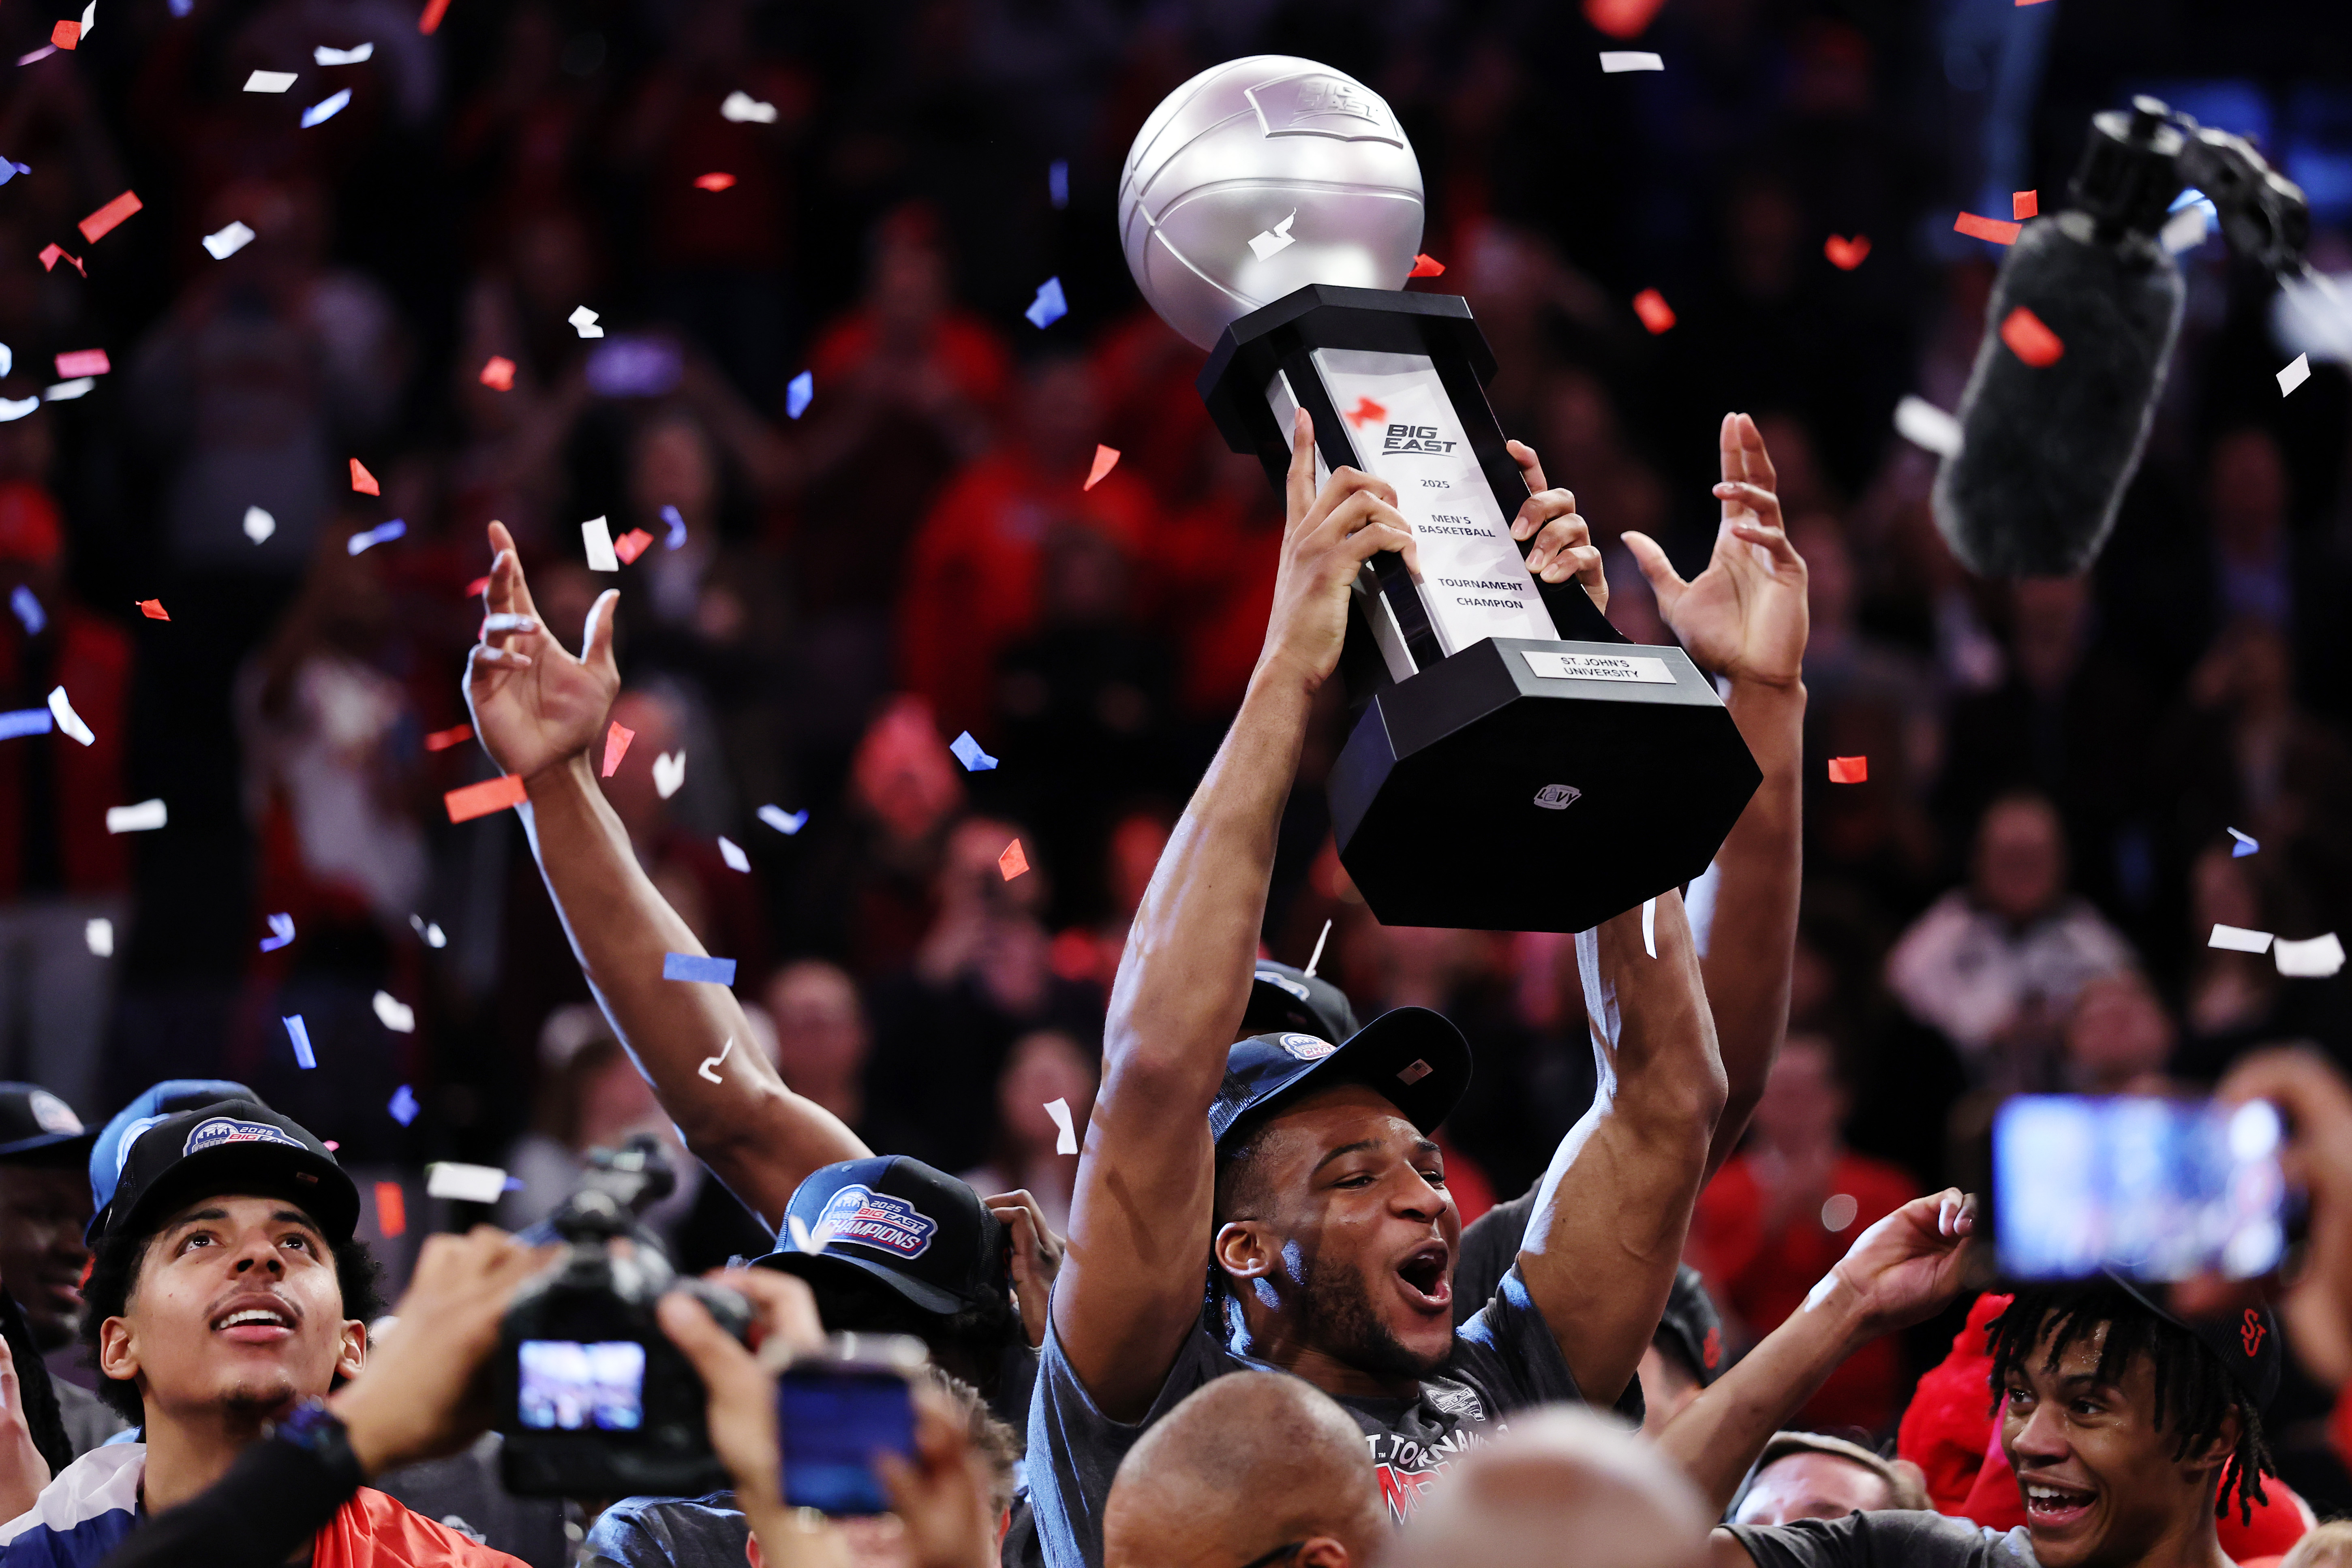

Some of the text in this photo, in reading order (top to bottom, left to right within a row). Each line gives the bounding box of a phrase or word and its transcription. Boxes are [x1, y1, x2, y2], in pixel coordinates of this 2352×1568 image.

[1387, 424, 1438, 439] BIG
[1384, 438, 1457, 453] EAST
[1421, 479, 1450, 488] 2025
[1431, 514, 1471, 524] MEN'S
[1418, 525, 1496, 537] BASKETBALL
[1438, 579, 1523, 590] TOURNAMENT
[1457, 598, 1524, 609] CHAMPION
[1561, 657, 1630, 667] ST. JOHN'S
[1563, 667, 1638, 678] UNIVERSITY
[240, 1127, 274, 1136] 2025
[870, 1200, 904, 1213] 2025
[858, 1208, 925, 1230] BIG EAST
